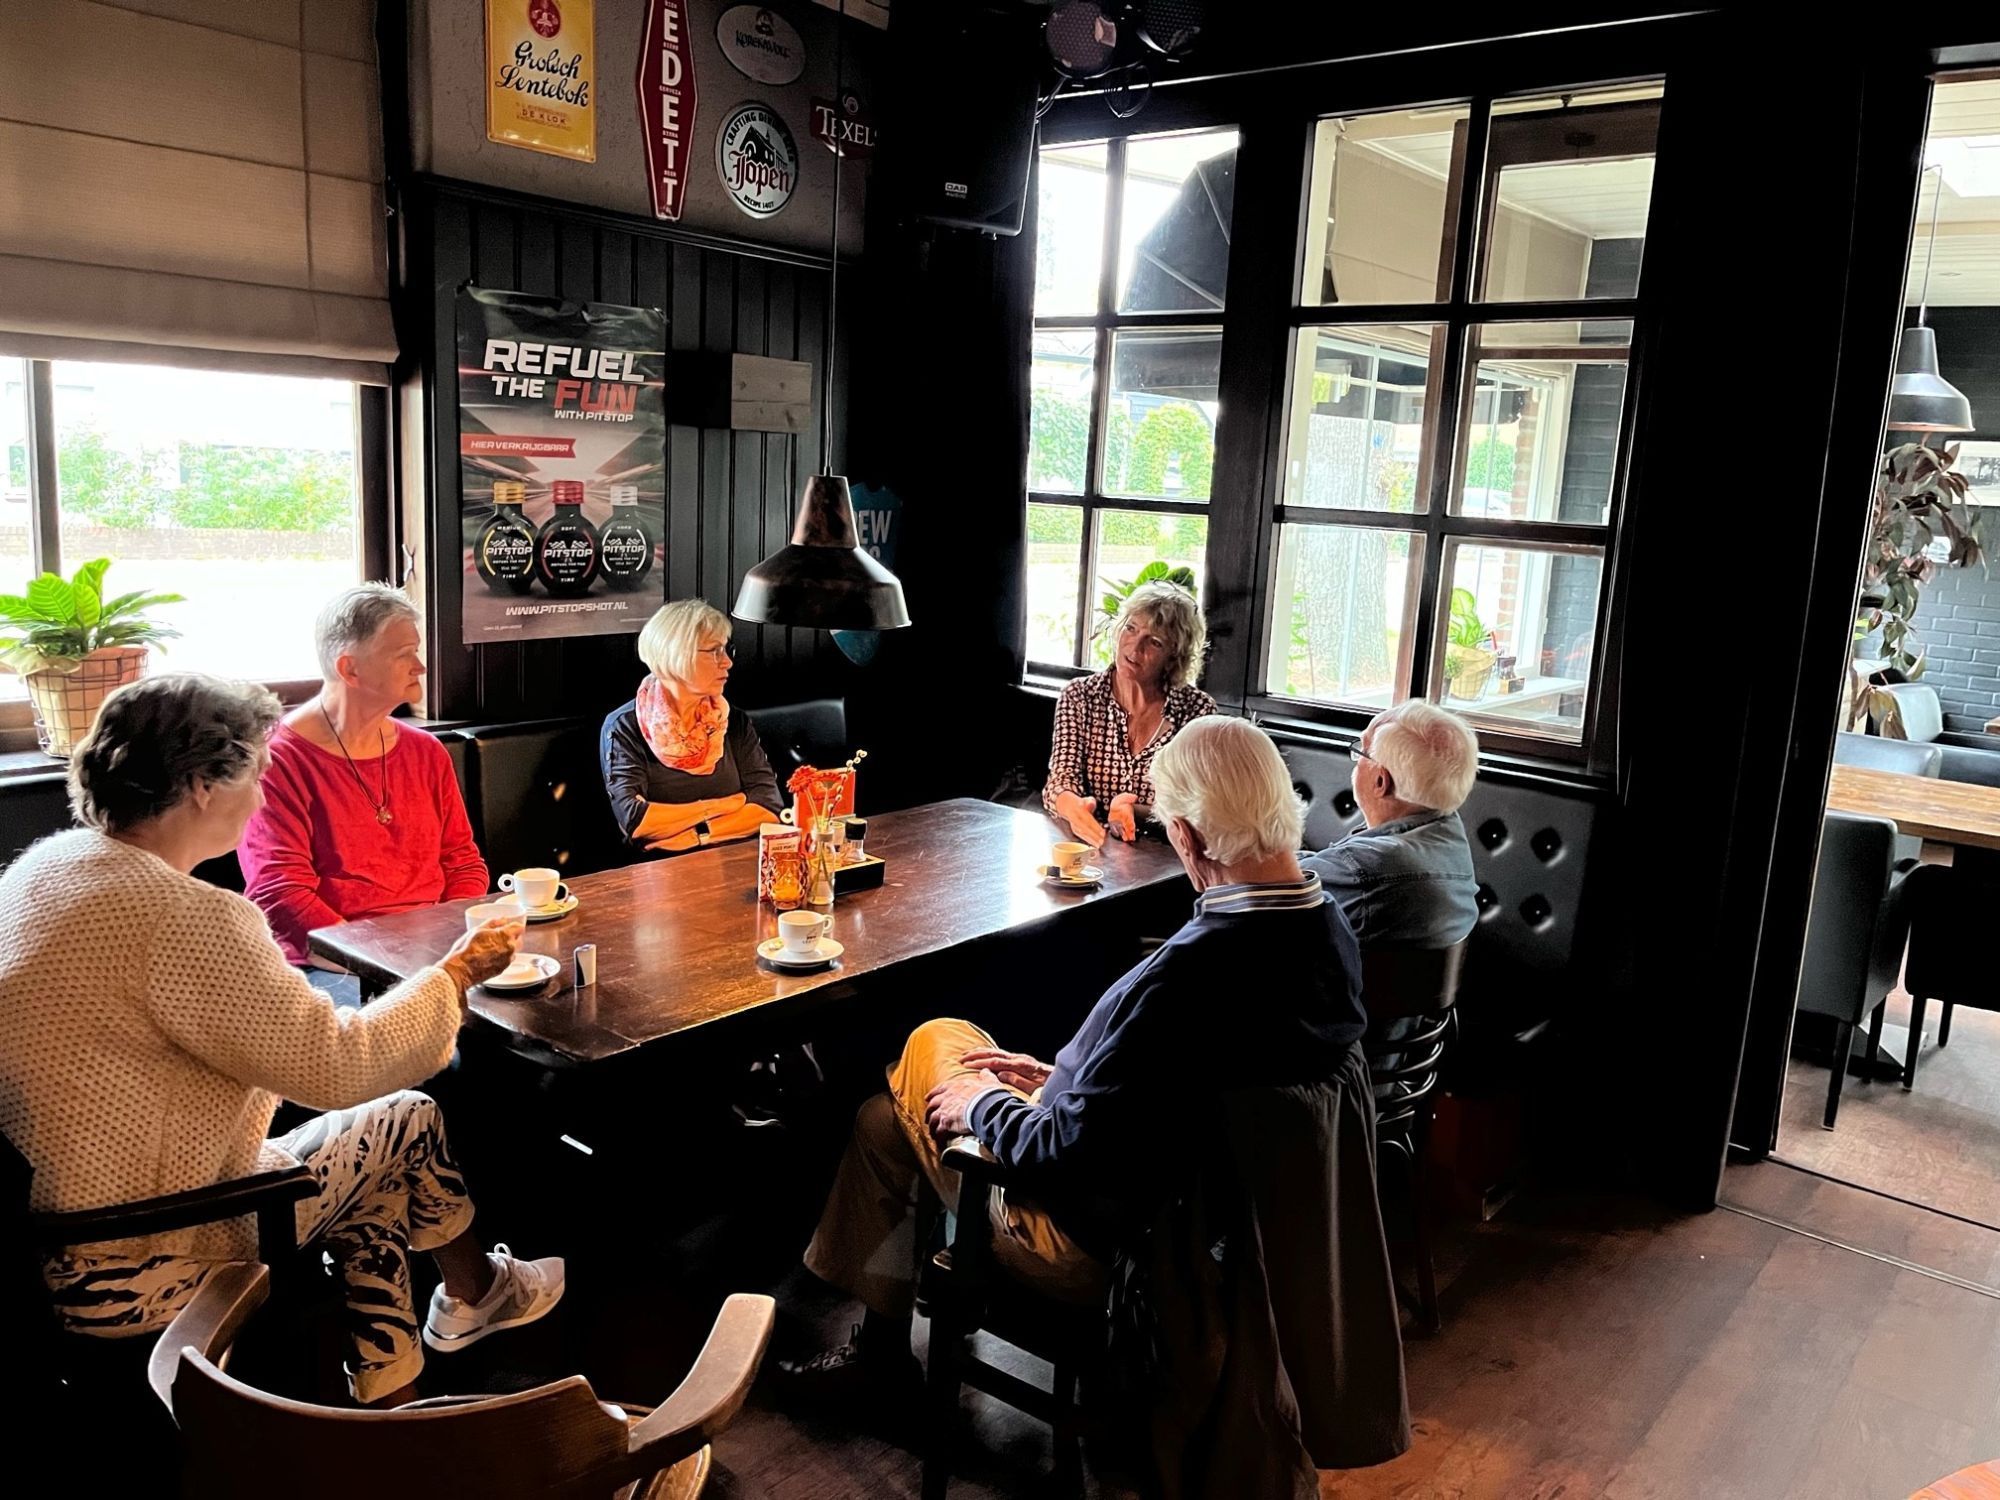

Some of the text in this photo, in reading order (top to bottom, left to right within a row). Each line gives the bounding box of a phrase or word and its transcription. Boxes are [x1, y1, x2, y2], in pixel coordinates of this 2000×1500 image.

[515, 40, 582, 79] Grolsch
[495, 64, 589, 107] Lentebok
[726, 112, 757, 146] CRAFTING
[726, 150, 789, 197] Jopen
[484, 339, 645, 382] REFUEL
[491, 375, 638, 413] THE FUN
[554, 409, 634, 423] WITH PITSTOP
[471, 440, 570, 451] HIER VERKRIJGBAAR
[486, 546, 533, 556] PITSTOP
[544, 548, 593, 558] PITSTOP
[603, 545, 645, 554] PITSTOP
[505, 602, 629, 616] WWW.PITSTOPSHOT.NL
